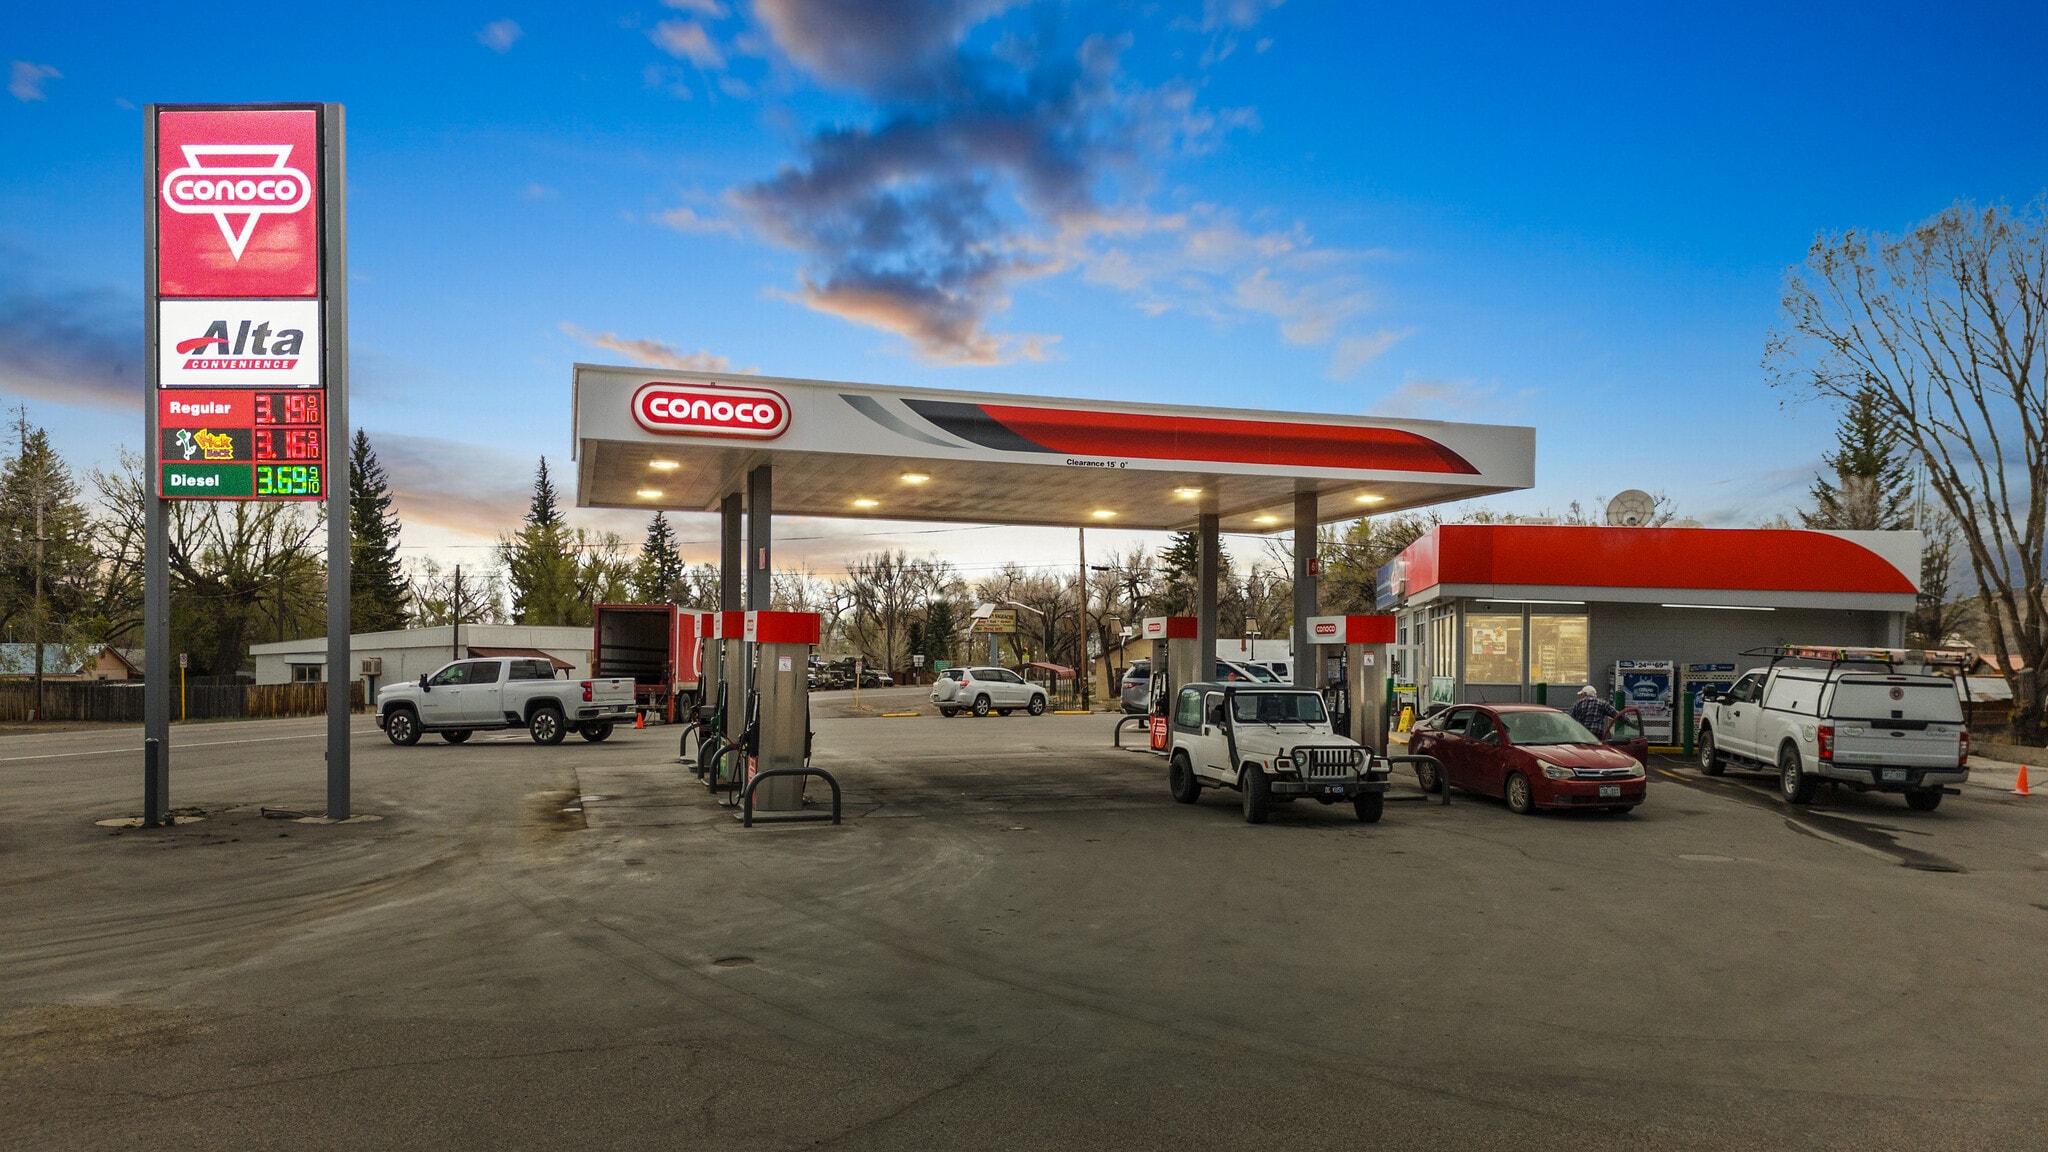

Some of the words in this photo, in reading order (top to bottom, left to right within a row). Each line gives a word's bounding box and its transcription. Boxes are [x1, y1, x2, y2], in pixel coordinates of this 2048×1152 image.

[191, 320, 304, 356] Alta
[191, 360, 289, 369] CONVENIENCE
[169, 401, 231, 416] Regular
[256, 395, 305, 423] 3.19
[257, 431, 306, 458] 3.16
[1066, 458, 1105, 467] Clearance
[170, 474, 219, 487] Diesel
[258, 466, 307, 494] 3.69
